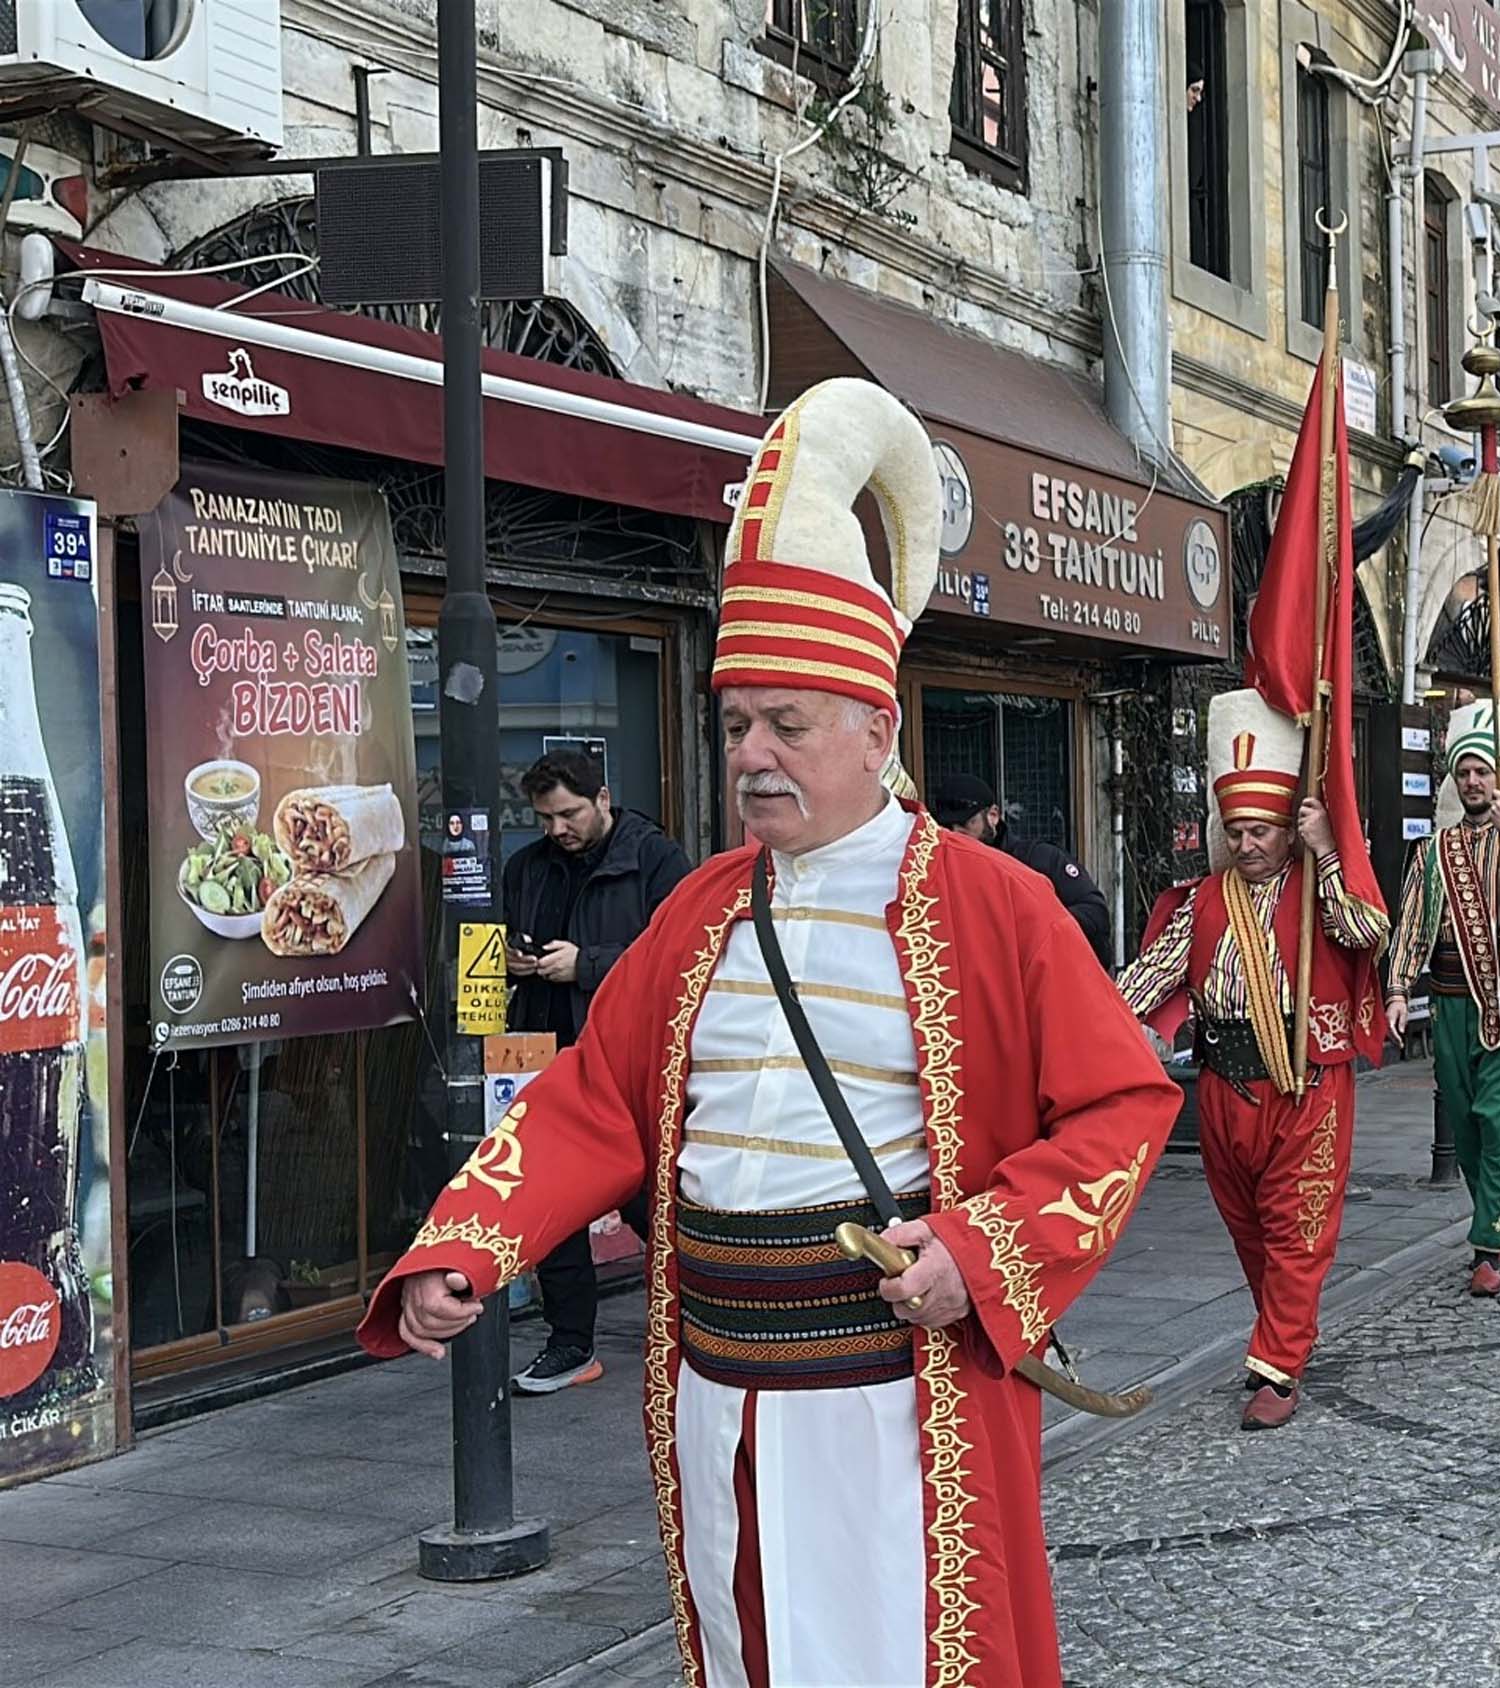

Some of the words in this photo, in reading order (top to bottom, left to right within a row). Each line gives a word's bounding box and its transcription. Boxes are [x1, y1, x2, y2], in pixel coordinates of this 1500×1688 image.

[211, 380, 281, 411] şenpiliç
[189, 487, 300, 530] RAMAZAN'IN
[303, 506, 343, 534] TADI
[1032, 472, 1138, 542] EFSANE
[185, 525, 299, 564] TANTUNİYLE
[302, 534, 358, 573] ÇIKAR!
[1003, 521, 1041, 573] 33
[1048, 532, 1165, 600] TANTUNİ
[191, 588, 225, 613] İFTAR
[228, 597, 285, 616] SAATLERİNDE
[287, 599, 330, 619] TANTUNİ
[938, 565, 972, 605] İLİÇ
[1040, 594, 1070, 622] Tel:
[1073, 600, 1100, 627] 214
[1103, 606, 1121, 631] 40
[1124, 610, 1141, 635] 80
[1190, 616, 1221, 649] PİLİÇ
[190, 622, 279, 687] Çorba
[303, 628, 378, 678] Salata
[232, 671, 363, 736] BİZDEN!
[164, 977, 191, 990] EFSANE
[241, 979, 288, 1005] Şimdiden
[315, 974, 343, 993] olsun,
[343, 972, 360, 993] hoş
[221, 1017, 242, 1033] 0286
[242, 1014, 258, 1031] 214
[259, 1013, 269, 1028] 40
[270, 1012, 281, 1027] 80
